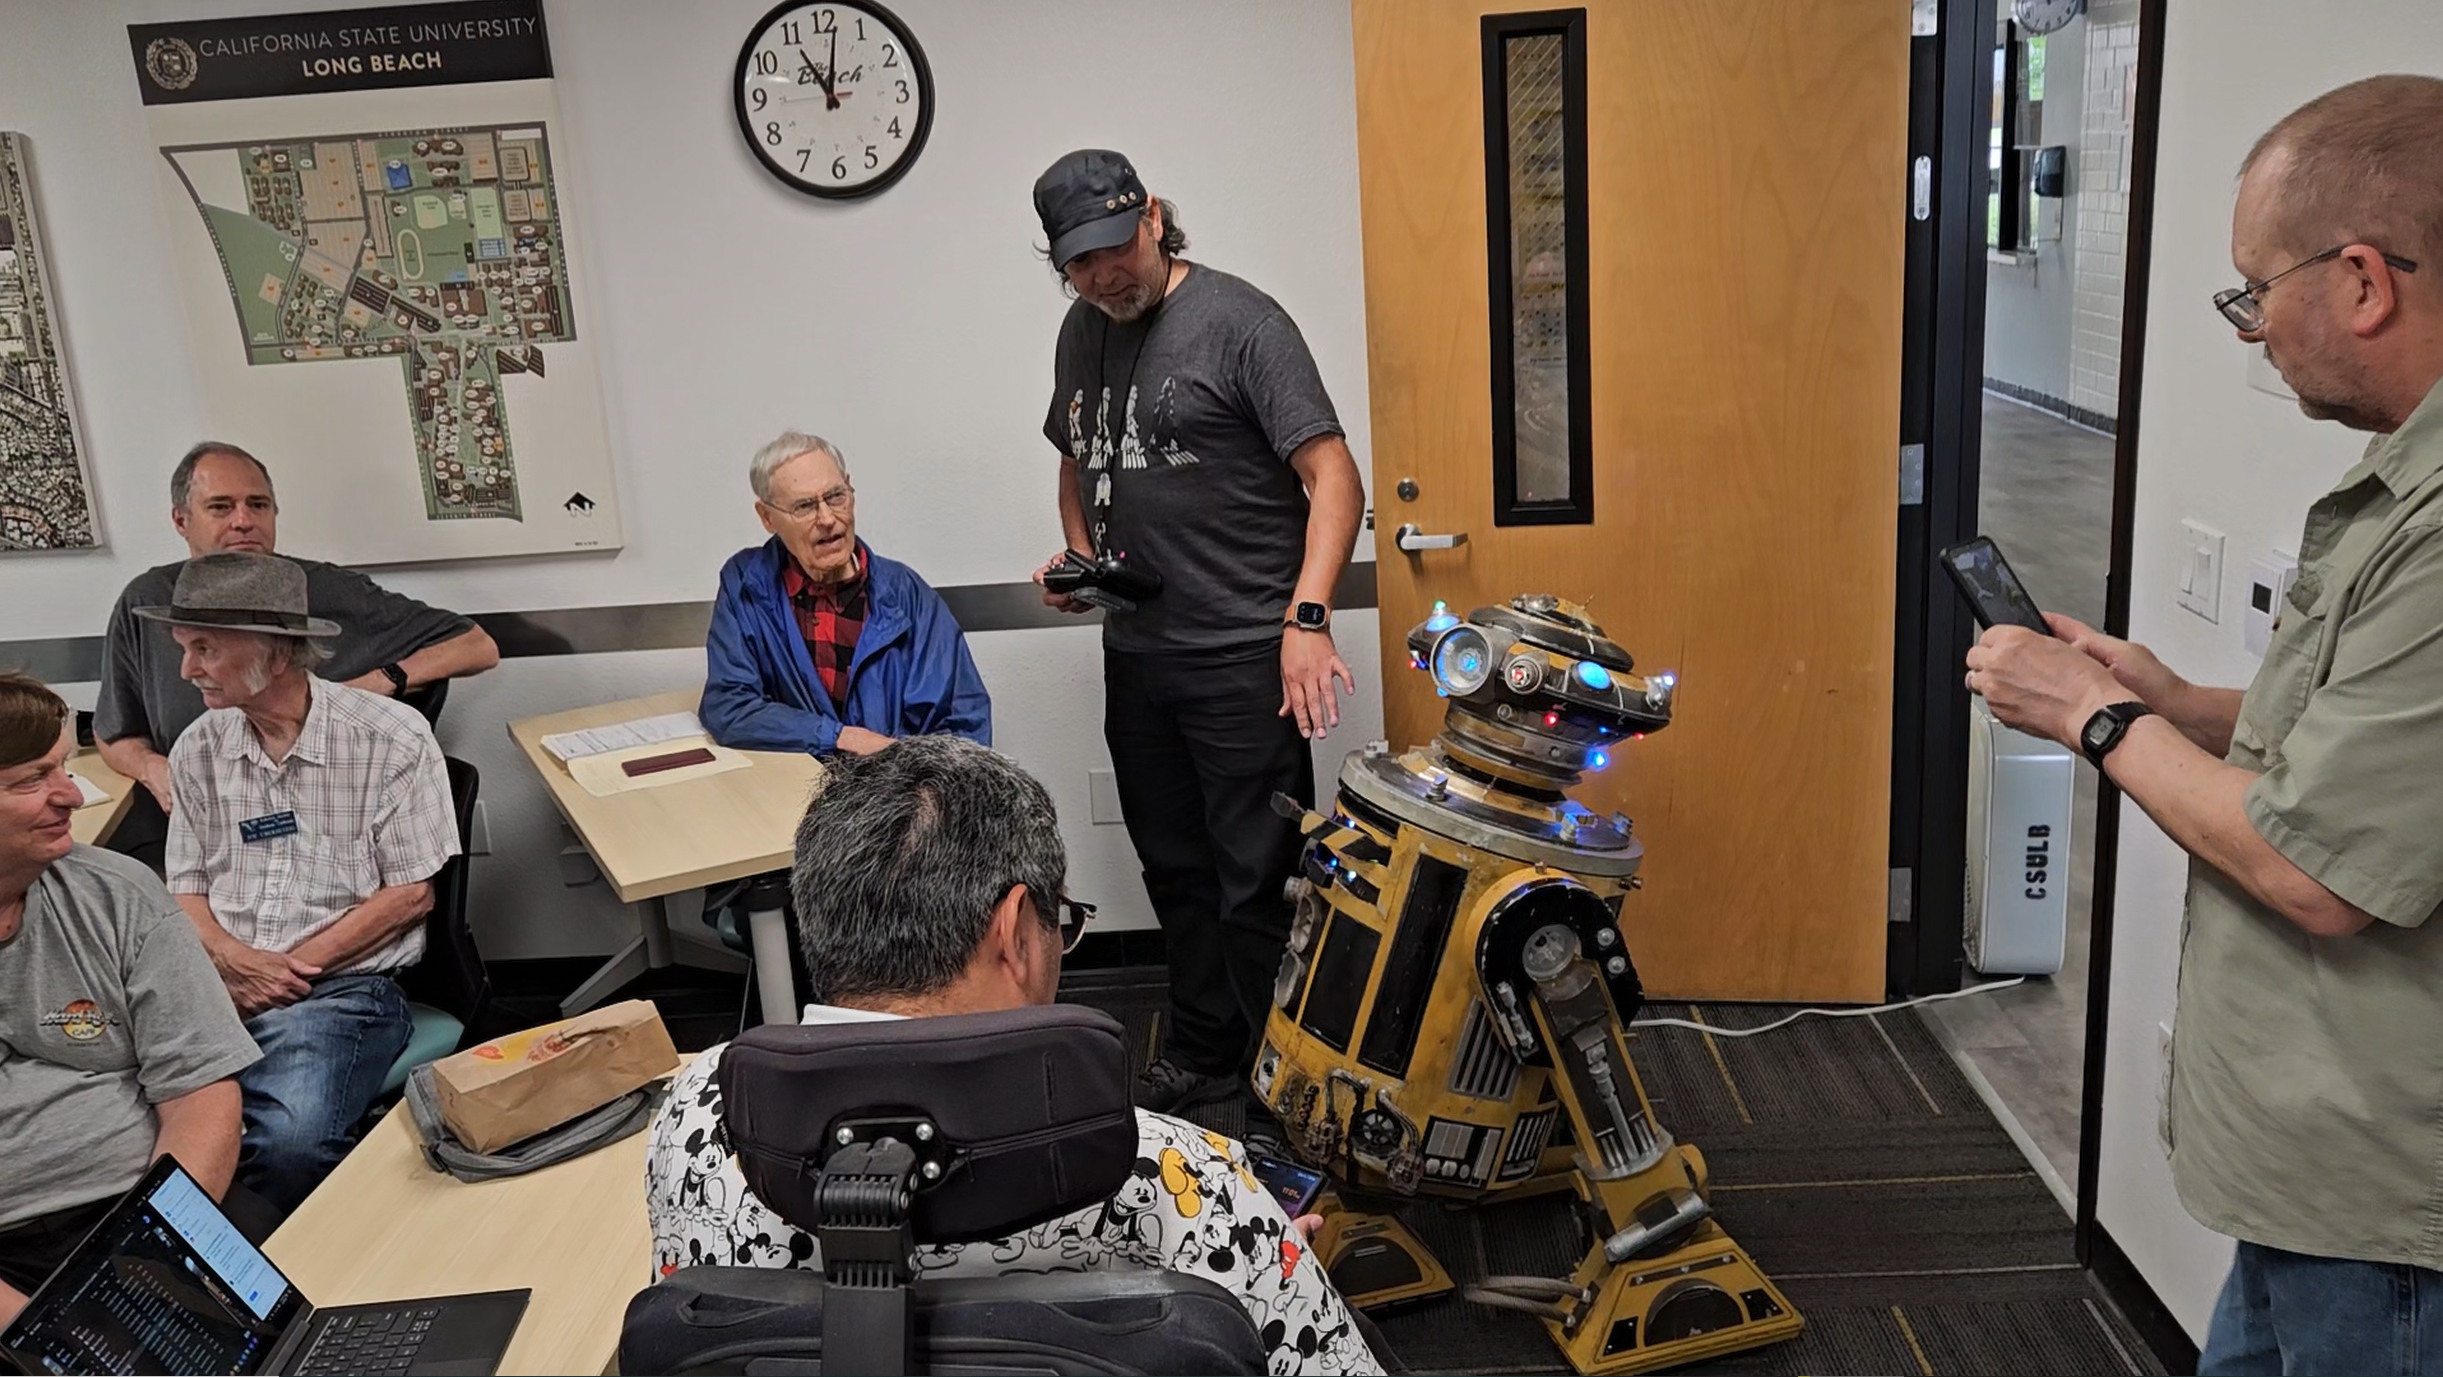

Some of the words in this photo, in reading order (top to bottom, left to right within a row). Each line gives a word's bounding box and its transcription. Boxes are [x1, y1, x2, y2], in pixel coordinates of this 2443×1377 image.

[780, 21, 803, 46] 11
[810, 9, 836, 35] 12
[855, 17, 867, 41] 1
[199, 32, 333, 58] CALIFORNIA
[338, 27, 401, 48] STATE
[409, 17, 537, 42] UNIVERSITY
[302, 56, 363, 77] LONG
[371, 51, 443, 73] BEACH
[754, 50, 779, 76] 10
[882, 43, 898, 69] 2
[752, 88, 768, 112] 9
[895, 80, 910, 104] 3
[766, 121, 782, 146] 8
[887, 116, 903, 139] 4
[796, 149, 811, 173] 7
[831, 155, 847, 180] 6
[864, 145, 879, 169] 5
[2024, 824, 2051, 900] CSULB
